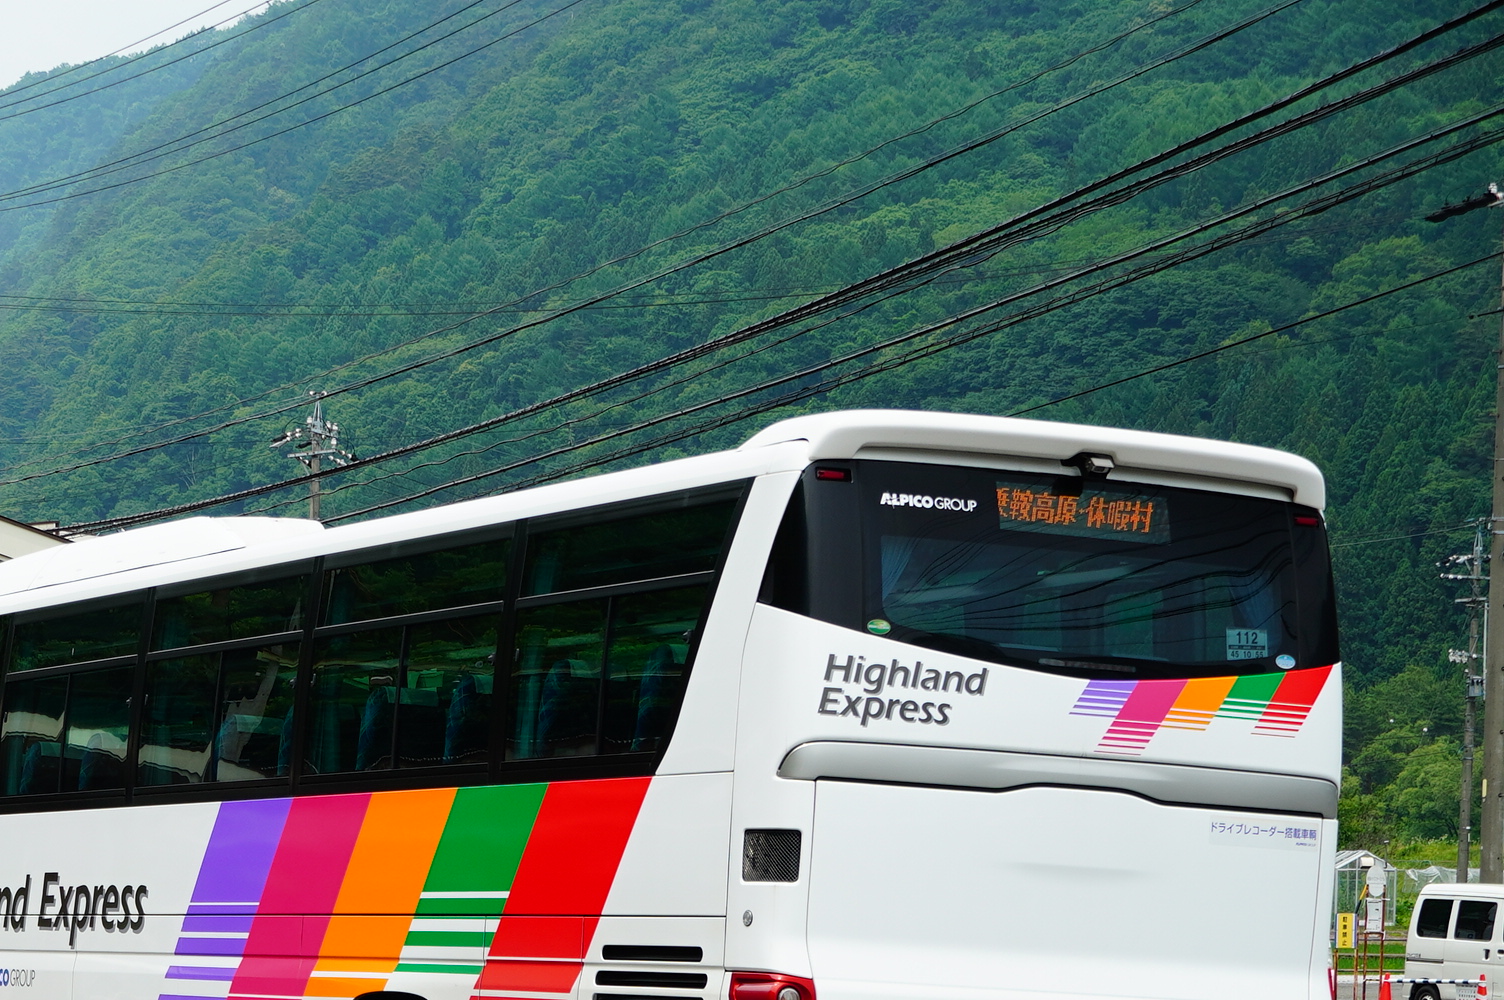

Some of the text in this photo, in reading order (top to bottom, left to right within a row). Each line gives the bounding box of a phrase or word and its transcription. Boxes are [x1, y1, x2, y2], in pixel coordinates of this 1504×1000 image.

[880, 492, 978, 512] ALPICO GROUP
[1236, 631, 1258, 645] 112
[822, 652, 989, 703] Highland
[818, 687, 953, 729] Express
[37, 871, 149, 949] Express
[10, 968, 36, 988] GROUP
